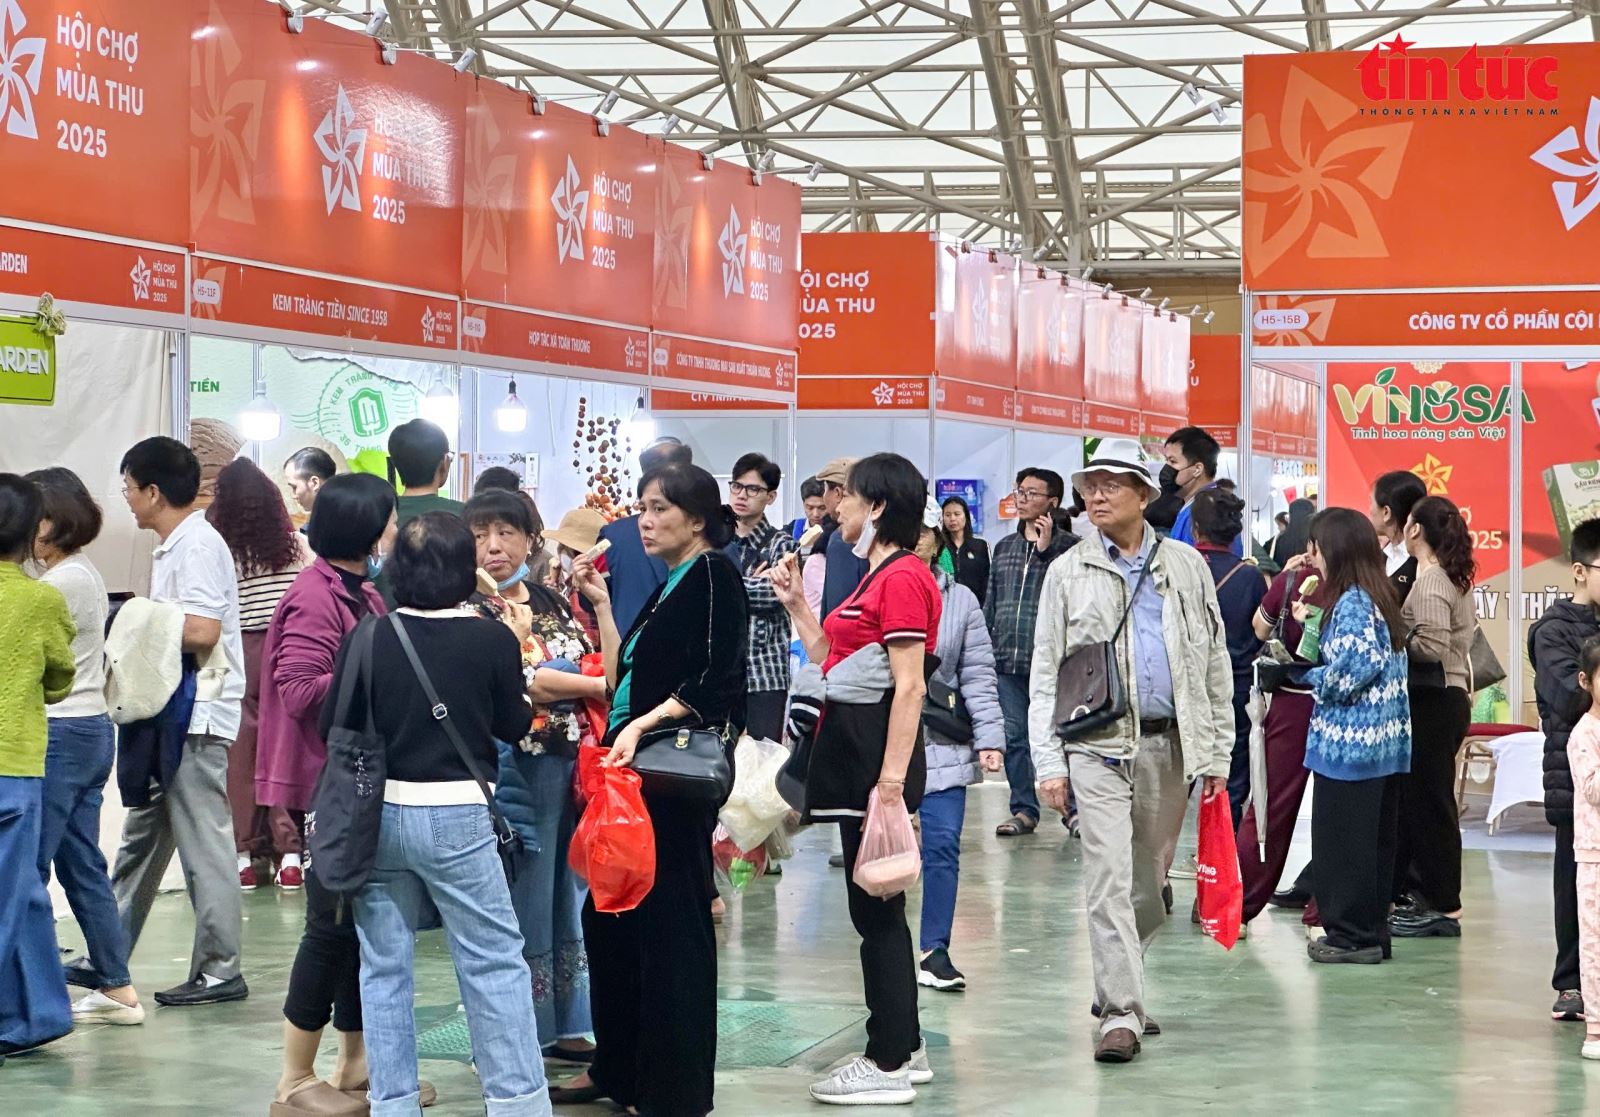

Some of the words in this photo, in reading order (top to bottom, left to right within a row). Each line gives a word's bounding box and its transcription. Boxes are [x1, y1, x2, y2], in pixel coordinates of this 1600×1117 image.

[56, 11, 92, 58] HỘI
[96, 27, 139, 73] CHỢ
[56, 62, 100, 106] MÙA
[105, 79, 144, 116] THU
[57, 119, 107, 158] 2025
[593, 170, 610, 203] HỘI
[612, 179, 632, 209] CHỢ
[372, 194, 405, 224] 2025
[592, 205, 614, 234] MÙA
[616, 216, 634, 240] THU
[750, 215, 764, 243] HỘI
[764, 222, 781, 248] CHỢ
[0, 252, 28, 274] RDEN
[592, 245, 616, 270] 2025
[750, 245, 767, 271] MÙA
[768, 254, 783, 274] THU
[166, 278, 177, 289] THU
[750, 281, 769, 302] 2025
[800, 268, 821, 292] ỘI
[825, 270, 870, 292] CHỢ
[153, 292, 168, 303] 2025
[272, 293, 292, 311] KEM
[294, 294, 324, 318] TRÀNG
[347, 305, 370, 324] SINCE
[371, 309, 388, 327] 1958
[800, 293, 830, 313] ÙA
[835, 298, 875, 313] THU
[798, 323, 836, 338] 025
[1408, 311, 1456, 330] CÔNG
[1460, 313, 1481, 330] TY
[1485, 307, 1509, 330] CỔ
[1564, 310, 1594, 331] CỘI
[1352, 427, 1378, 439] Tinh
[1383, 427, 1408, 439] hoa
[1412, 426, 1445, 441] nông
[1449, 427, 1474, 439] sản
[1479, 426, 1505, 440] Việt
[1469, 530, 1503, 550] 025
[1472, 585, 1500, 620] ẤY
